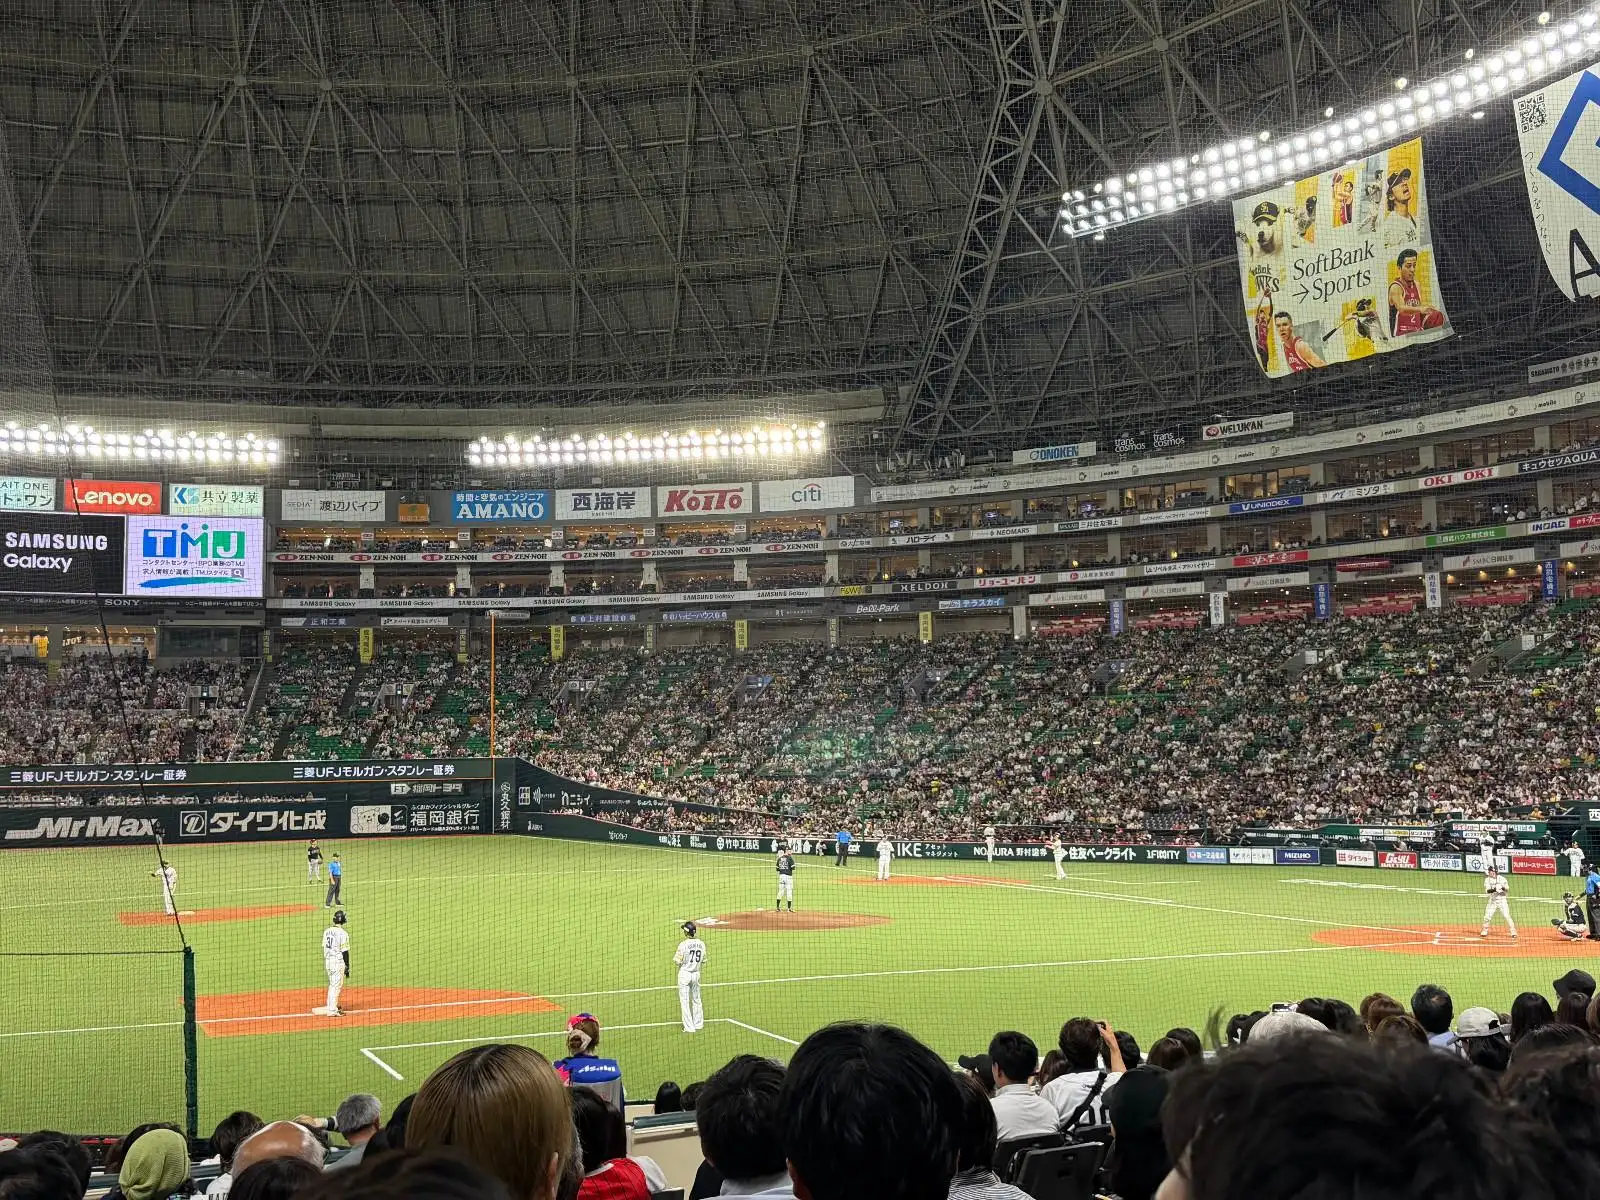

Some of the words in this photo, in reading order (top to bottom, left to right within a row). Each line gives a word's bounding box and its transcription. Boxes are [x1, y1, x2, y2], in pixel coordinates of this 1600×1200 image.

[1293, 239, 1376, 281] SoftBank
[1312, 269, 1371, 303] Sports
[1115, 437, 1135, 447] trans
[1153, 432, 1174, 441] trans
[1153, 436, 1185, 448] cosmos
[1115, 442, 1146, 453] cosmos
[1424, 475, 1453, 487] OKI
[1464, 468, 1494, 481] OKI
[24, 482, 49, 491] ONE
[72, 487, 153, 507] Lenovo
[202, 490, 260, 504] 共立製薬
[456, 493, 545, 502] 時間と空気のエンジニア
[792, 484, 821, 503] citi
[571, 491, 636, 511] 西海岸
[1251, 498, 1290, 509] UNIADEX
[456, 503, 544, 519] AMANO
[996, 527, 1030, 537] NEOMARS
[1532, 520, 1566, 531] INOAC
[5, 531, 109, 551] SAMSUNG
[143, 523, 246, 561] TMJ
[787, 543, 819, 551] ZEN-NOH
[720, 546, 752, 554] ZEN-NOH
[3, 553, 73, 573] Galaxy
[979, 575, 1036, 587] リョーユーパン
[293, 765, 456, 779] 三菱UFJモルガン・スタンレー証券
[210, 810, 327, 833] ダイワ化成
[410, 810, 480, 826] 福岡銀行
[5, 816, 158, 839] MrMax
[725, 838, 759, 850] 竹中工務店
[973, 847, 1014, 857] NOURA
[1069, 846, 1137, 861] 住友ベークライト
[1348, 854, 1373, 863] ダイショー
[689, 950, 702, 963] 79
